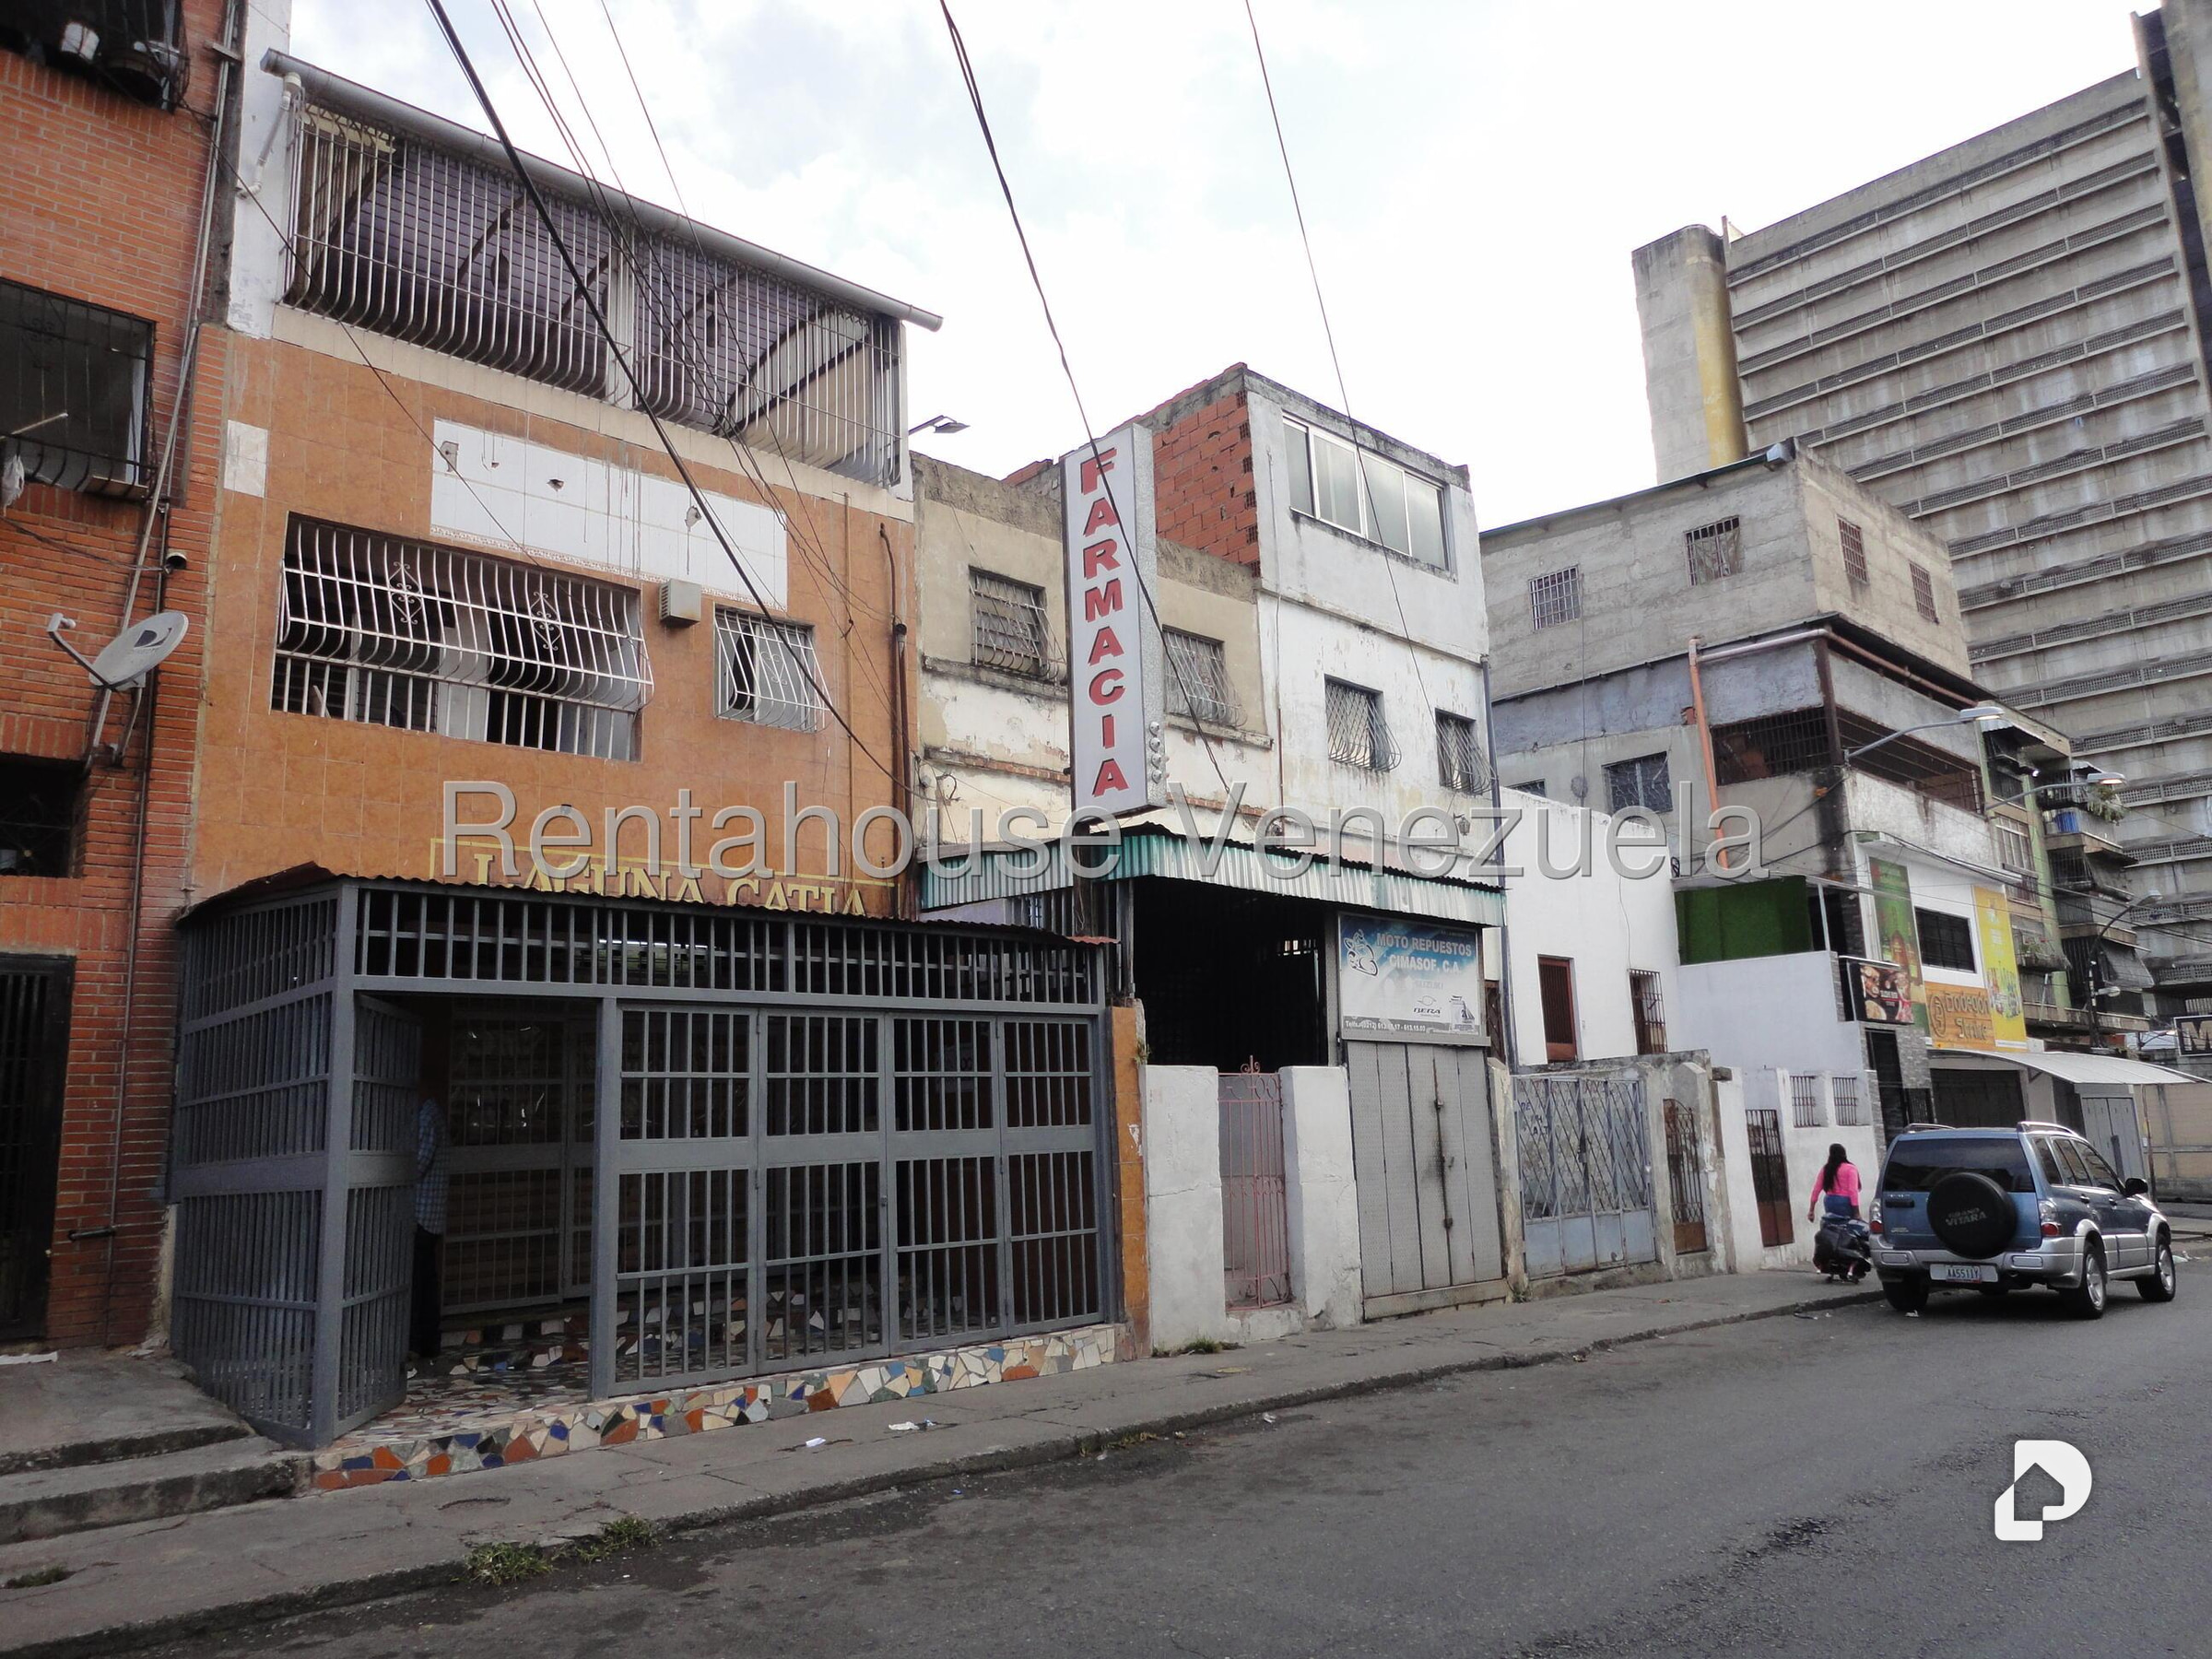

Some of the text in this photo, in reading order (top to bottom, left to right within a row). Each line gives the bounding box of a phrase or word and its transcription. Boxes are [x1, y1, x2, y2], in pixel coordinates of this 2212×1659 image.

[1080, 447, 1130, 798] FARMACIA
[1376, 933, 1473, 957] MOTO REPUESTOS
[1945, 1211, 1987, 1226] VITARA
